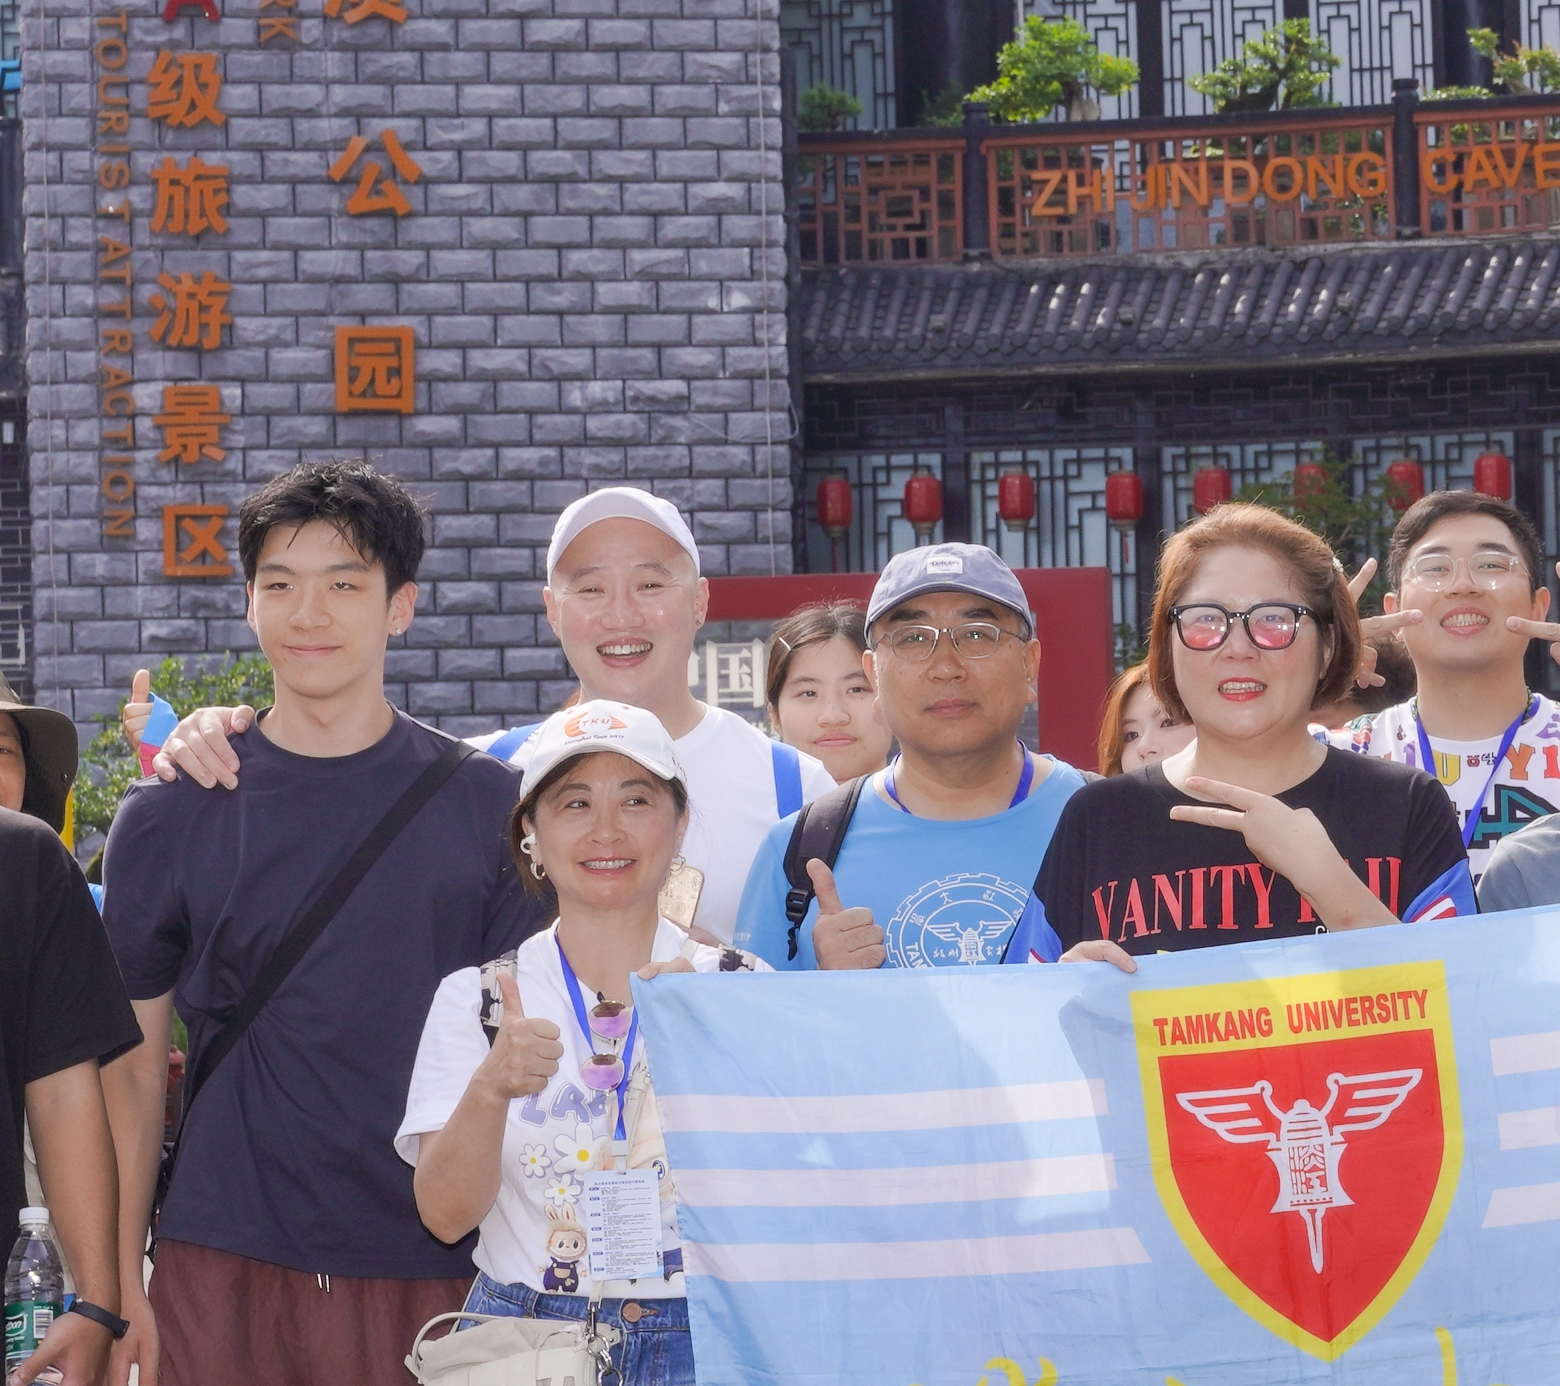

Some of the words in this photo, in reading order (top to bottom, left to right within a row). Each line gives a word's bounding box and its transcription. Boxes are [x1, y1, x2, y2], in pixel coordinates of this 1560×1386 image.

[92, 11, 132, 231] TOURIST
[97, 236, 135, 539] ATTRACTION
[582, 717, 611, 727] TKU
[1091, 861, 1278, 944] VANITY
[1153, 1006, 1274, 1046] TAMKANG
[1286, 989, 1429, 1035] UNIVERSITY
